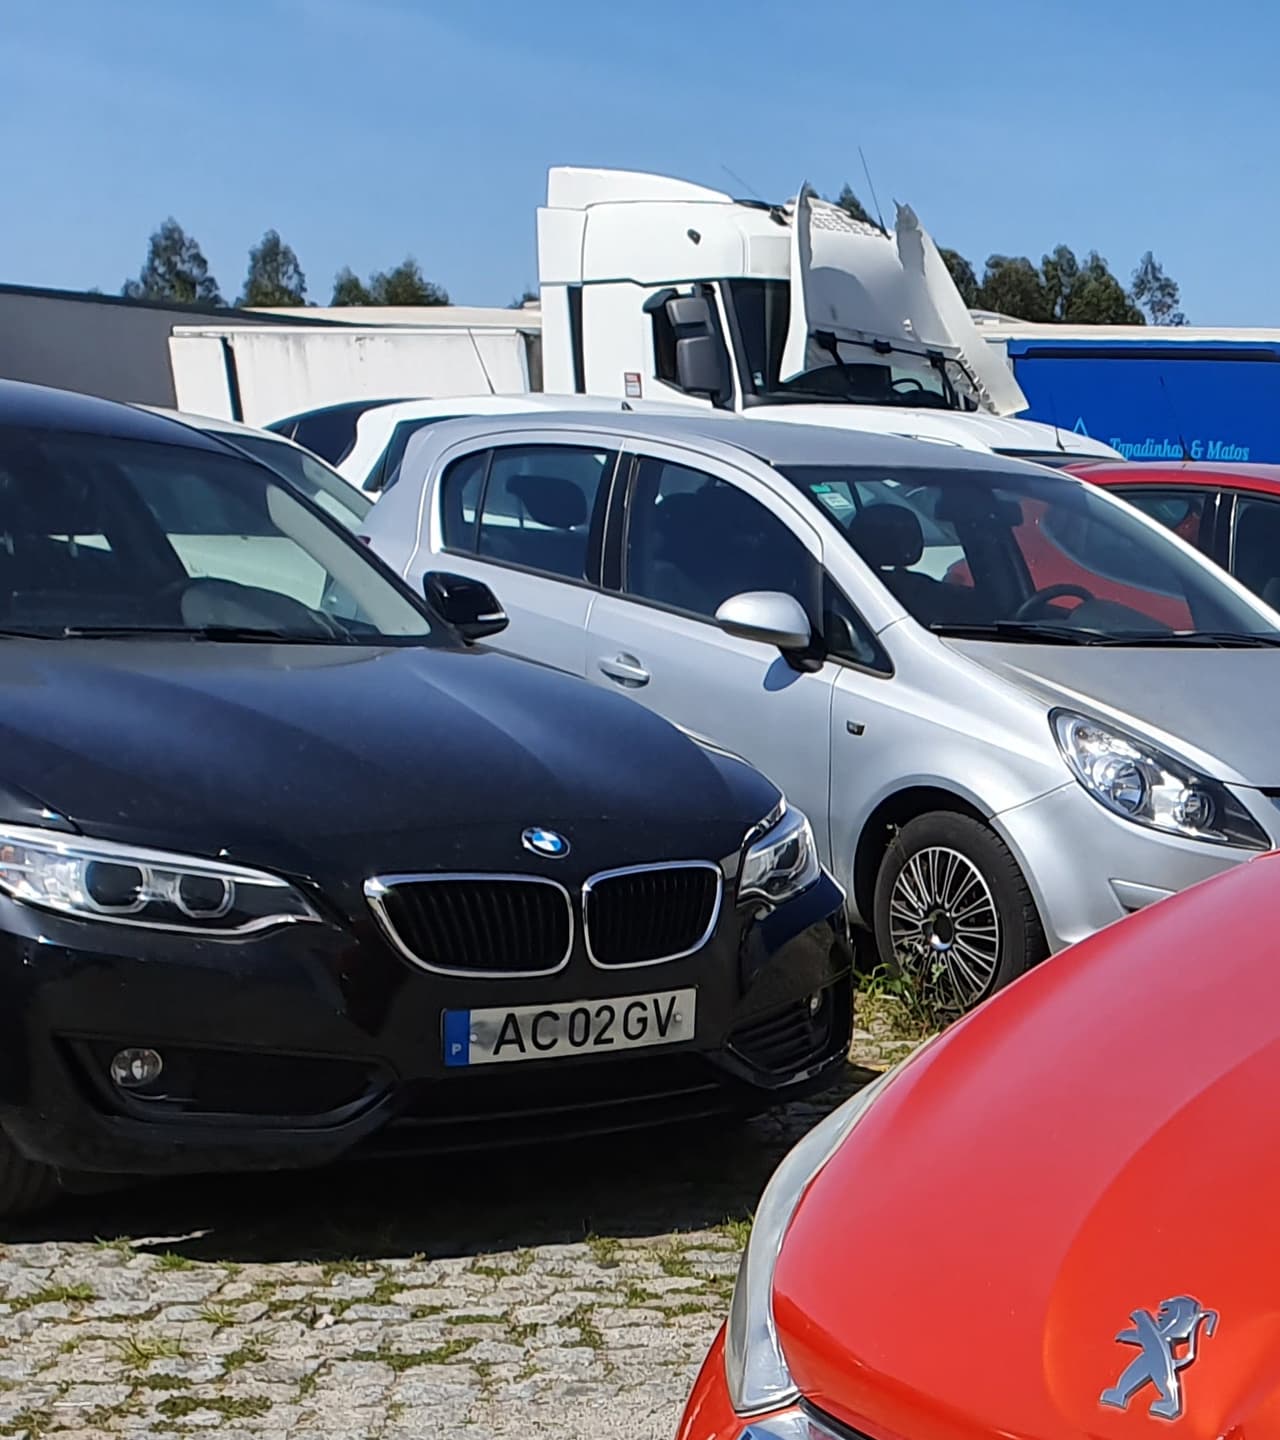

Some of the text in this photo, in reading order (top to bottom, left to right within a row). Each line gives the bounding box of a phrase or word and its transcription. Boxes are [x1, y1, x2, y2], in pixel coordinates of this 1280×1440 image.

[1191, 440, 1204, 458] &
[1207, 441, 1250, 460] Matos
[452, 1043, 462, 1055] P
